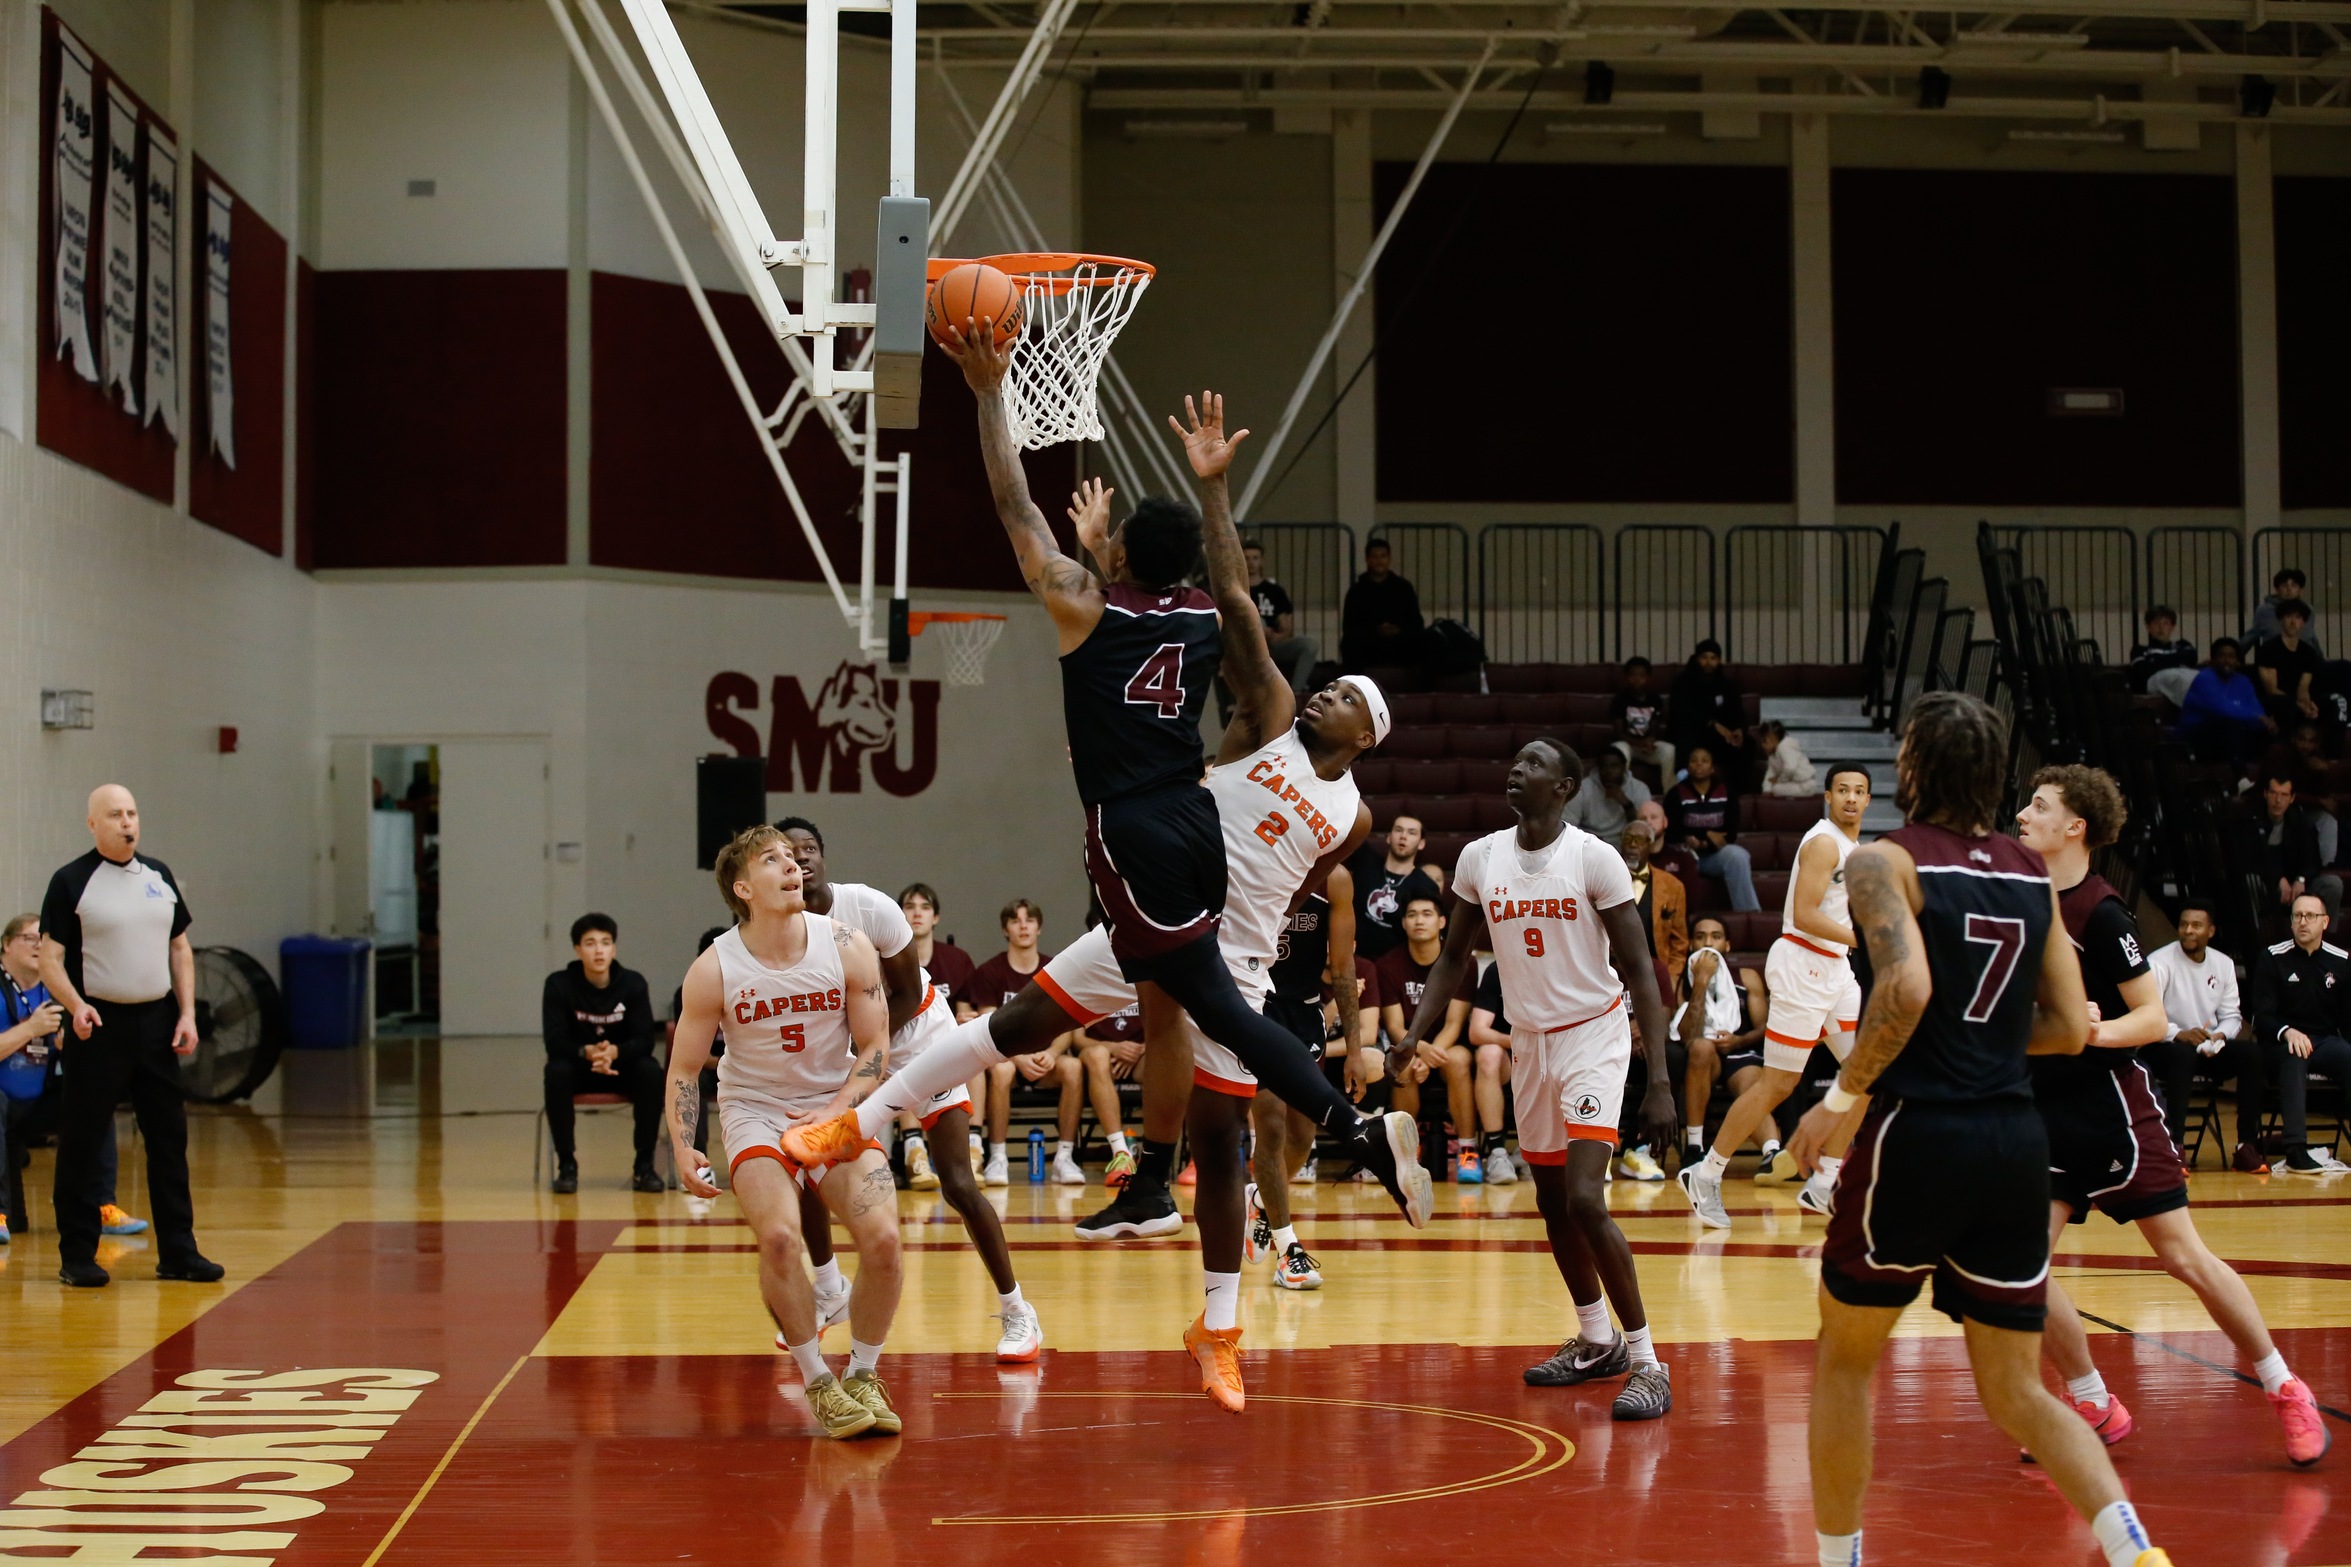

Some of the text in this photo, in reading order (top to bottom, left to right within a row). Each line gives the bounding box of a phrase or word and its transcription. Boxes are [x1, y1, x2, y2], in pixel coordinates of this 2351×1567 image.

[1258, 593, 1275, 616] LA
[1125, 643, 1186, 719] 4
[706, 671, 941, 797] SMU
[1246, 760, 1338, 849] CAPERS
[1253, 811, 1290, 848] 2
[1489, 897, 1577, 923] CAPERS
[1523, 927, 1545, 957] 9
[1963, 912, 2026, 1022] 7
[735, 988, 842, 1025] CAPERS
[780, 1023, 806, 1053] 5
[0, 1368, 440, 1567] HUSKIES
